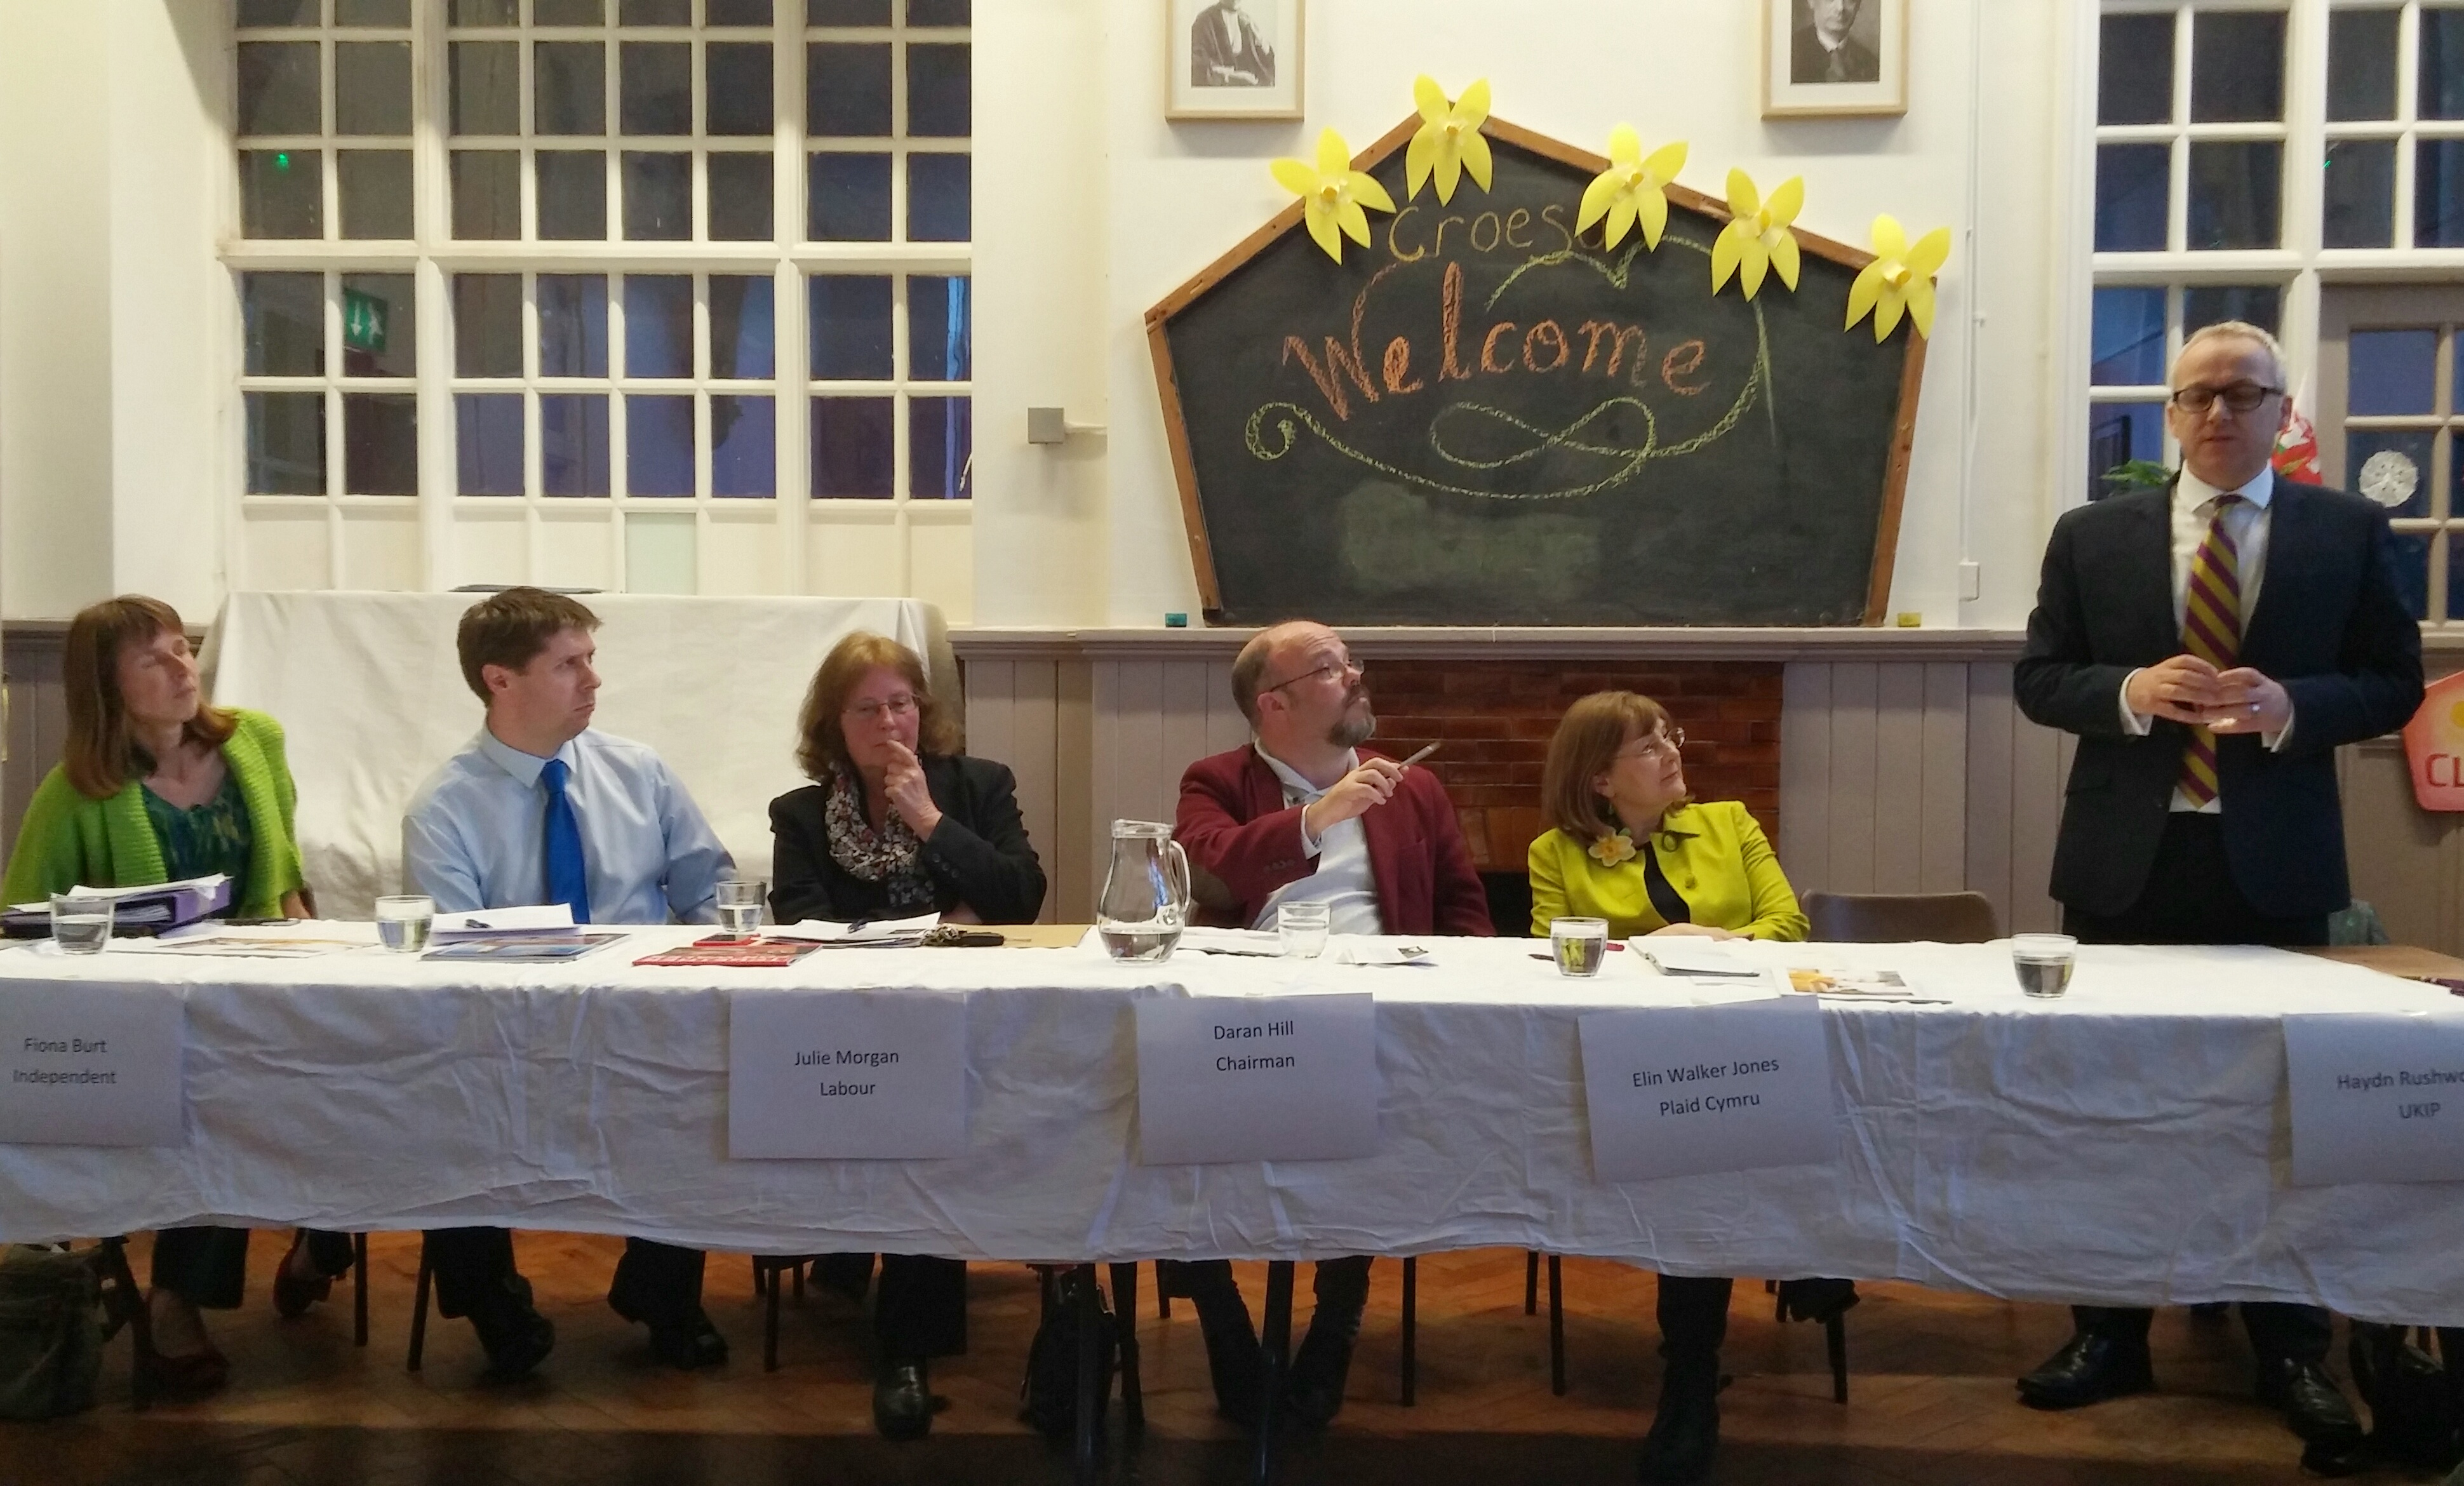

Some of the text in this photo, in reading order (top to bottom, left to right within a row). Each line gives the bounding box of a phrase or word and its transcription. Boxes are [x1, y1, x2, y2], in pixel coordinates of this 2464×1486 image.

[1282, 261, 1711, 421] Welcome
[1214, 1020, 1294, 1040] Daran Hill
[23, 1037, 107, 1054] Fiona Burt
[794, 1050, 899, 1068] Julie Morgan
[1216, 1055, 1296, 1072] Chairman
[13, 1068, 117, 1087] Independent
[1632, 1059, 1779, 1088] Elin Walker Jones
[2337, 1071, 2395, 1092] Haydn
[820, 1080, 876, 1097] Labour
[1659, 1094, 1761, 1116] Plaid Cymru
[2399, 1101, 2442, 1120] UKIP
